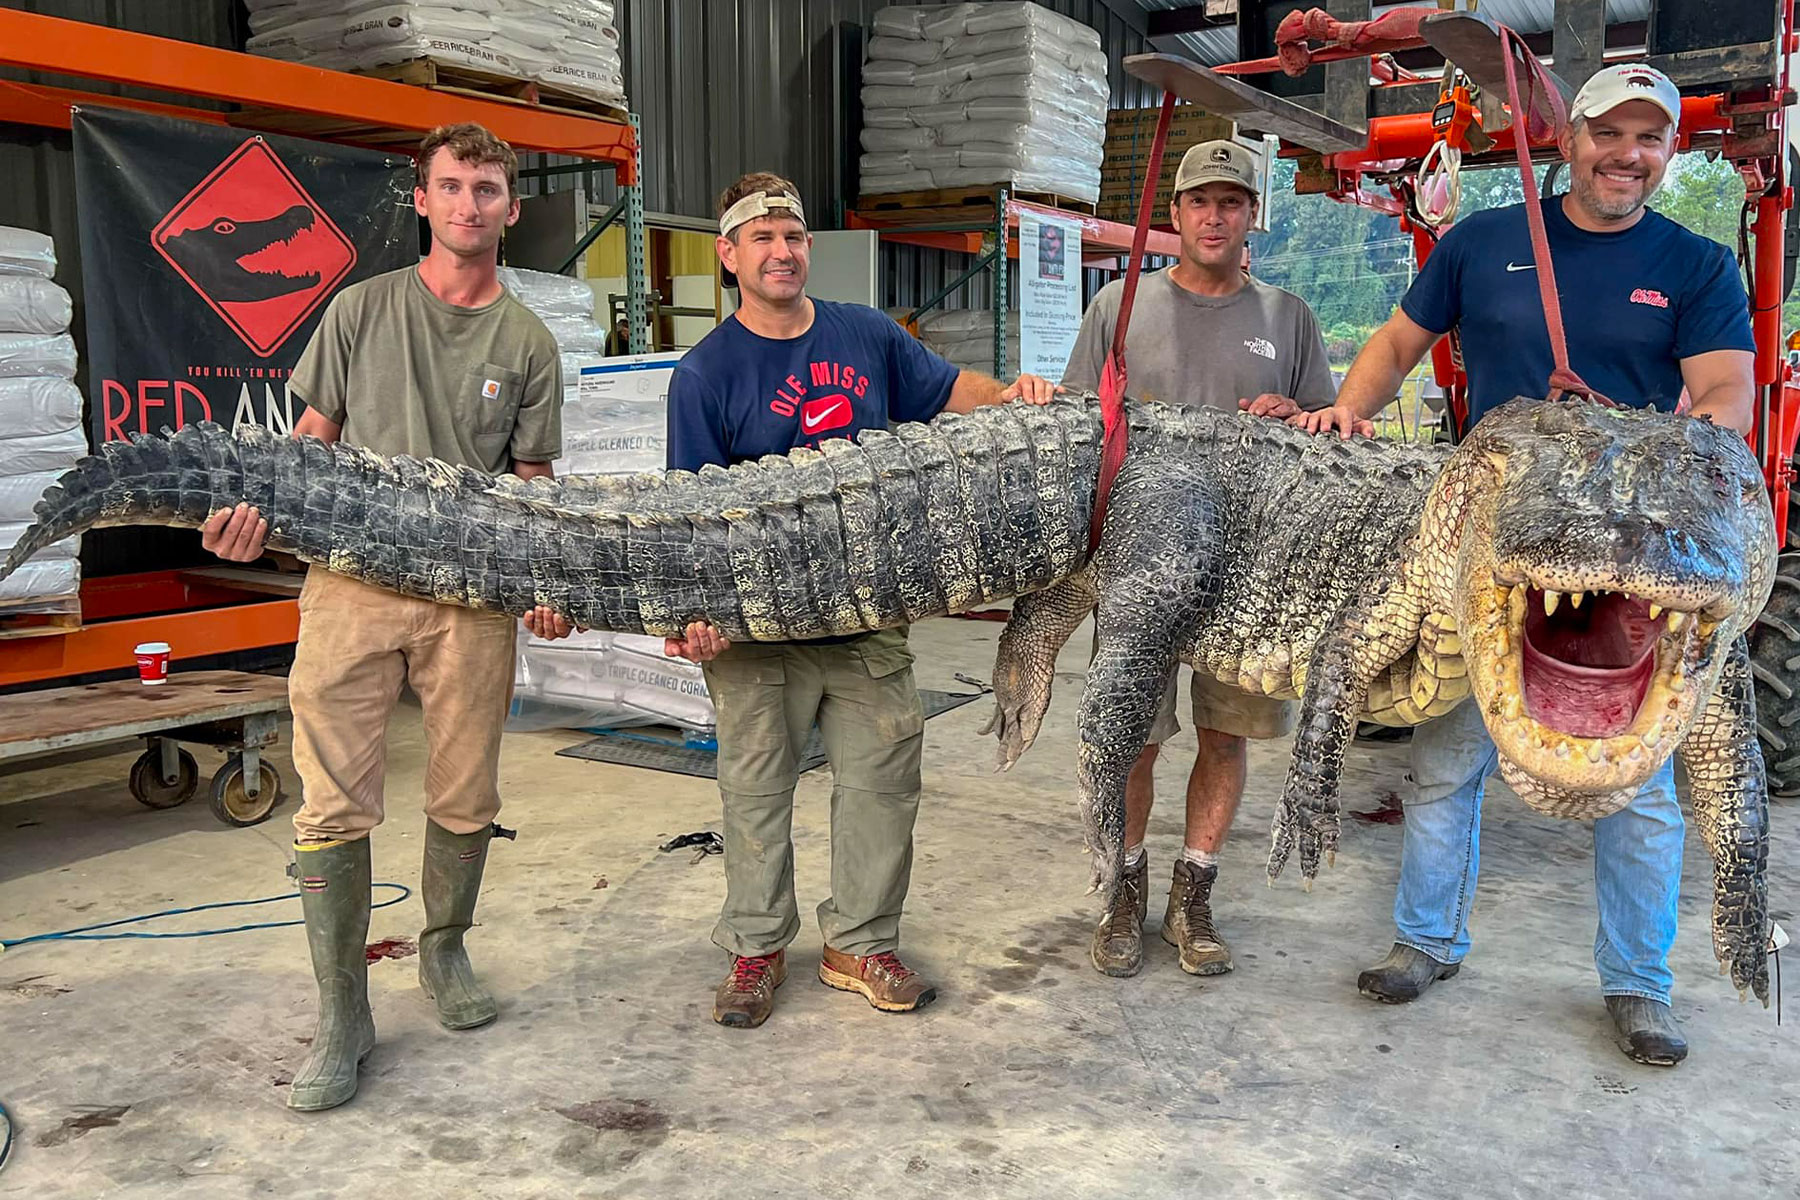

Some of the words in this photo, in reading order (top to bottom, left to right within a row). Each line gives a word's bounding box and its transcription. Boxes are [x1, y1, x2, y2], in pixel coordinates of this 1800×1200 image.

[1220, 163, 1240, 174] DEERE
[188, 366, 209, 377] YOU
[216, 367, 240, 378] KILL
[268, 368, 282, 378] WE
[770, 374, 807, 417] OLE
[810, 361, 869, 399] MISS
[102, 379, 212, 445] RED
[598, 436, 642, 452] CLEANED
[607, 665, 638, 681] TRIPLE
[637, 670, 678, 691] CLEANED
[680, 680, 707, 697] CORN
